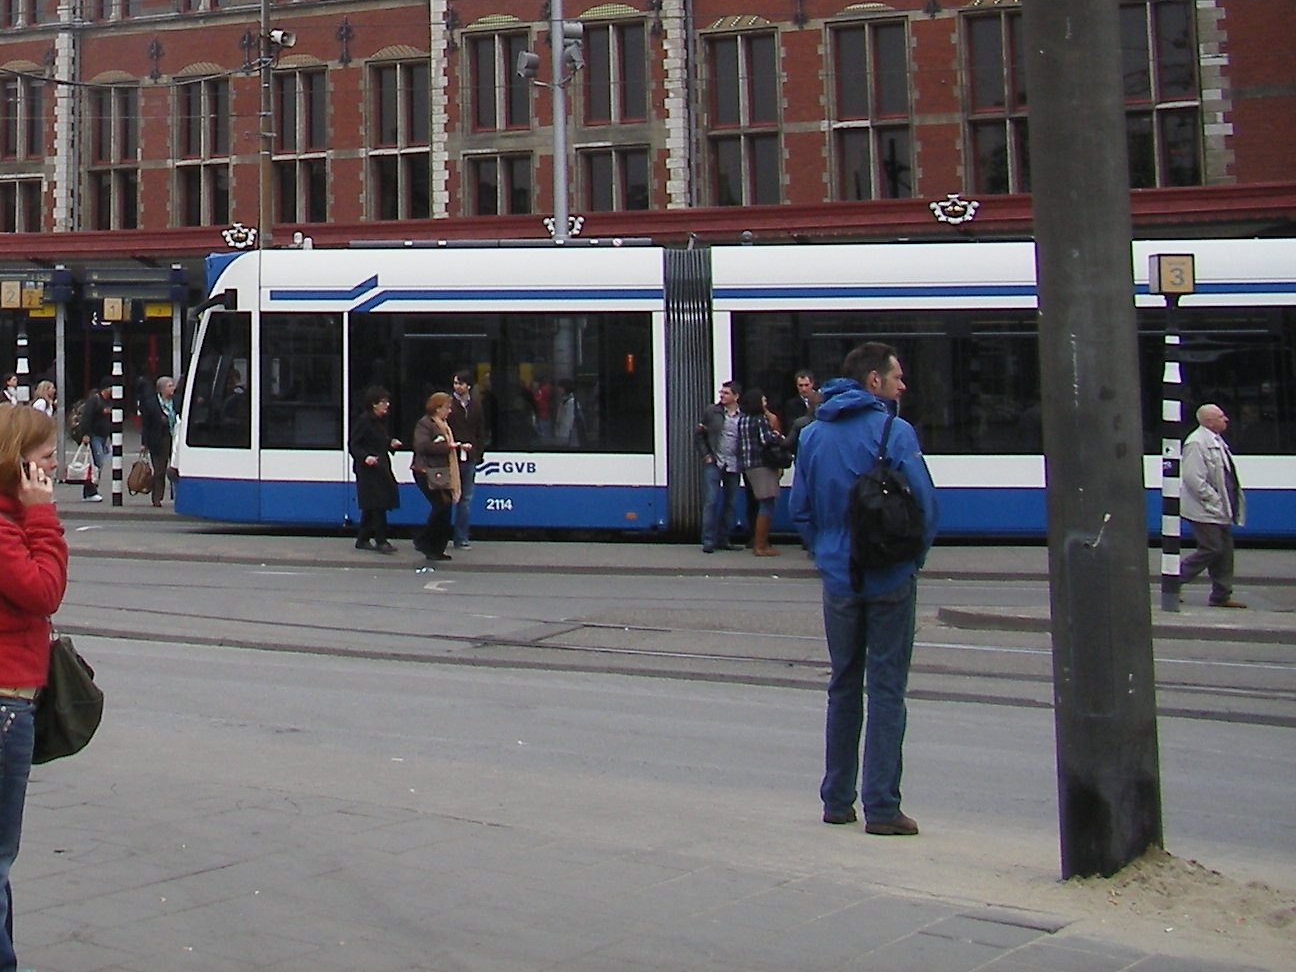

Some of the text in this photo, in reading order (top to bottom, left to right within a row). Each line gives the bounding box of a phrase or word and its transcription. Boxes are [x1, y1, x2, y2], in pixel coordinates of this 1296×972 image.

[1169, 268, 1185, 286] 3
[502, 461, 536, 473] GVB
[486, 498, 513, 510] 2114
